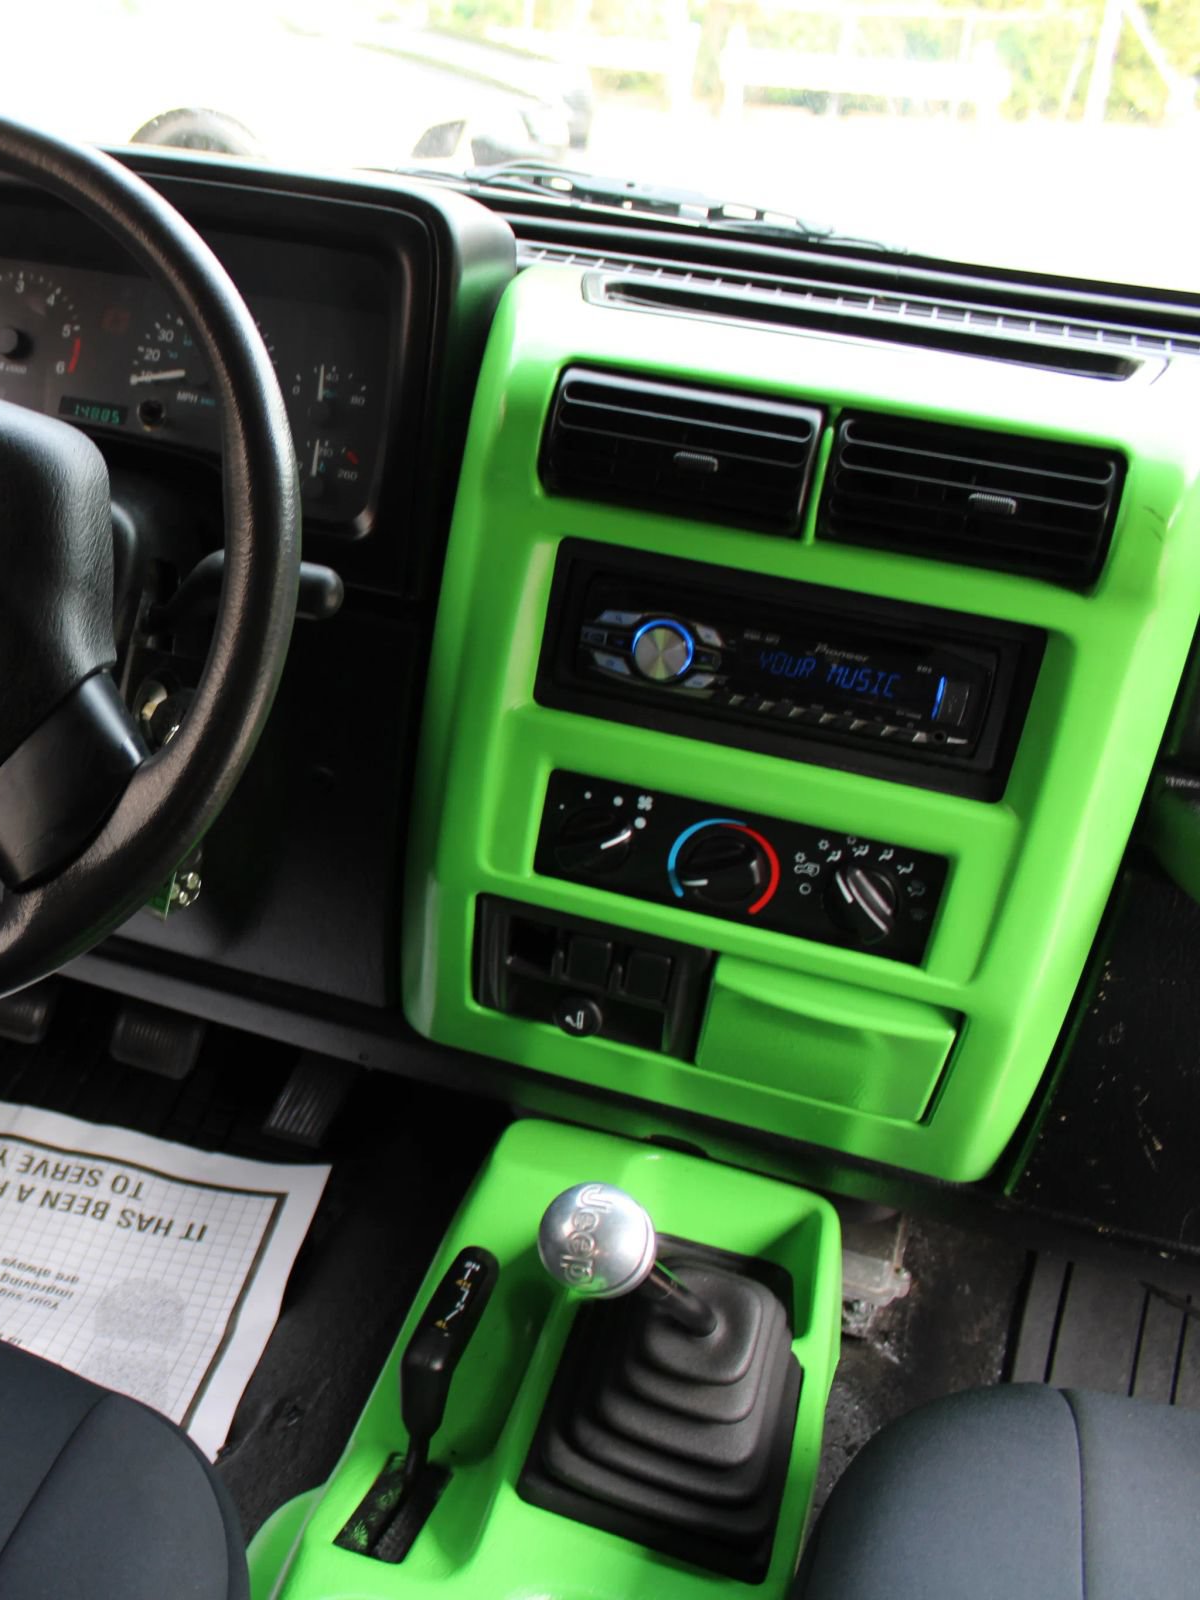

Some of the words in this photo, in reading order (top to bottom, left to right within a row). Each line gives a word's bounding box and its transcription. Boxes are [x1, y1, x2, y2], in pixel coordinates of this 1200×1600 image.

[15, 279, 25, 294] 3
[45, 293, 56, 307] 4
[62, 324, 71, 338] 5
[157, 328, 175, 343] 30
[144, 347, 161, 362] 20
[56, 361, 66, 375] 6
[814, 642, 870, 663] Pioneer
[758, 649, 817, 680] YOUR
[825, 662, 902, 700] MUSIC
[15, 1154, 104, 1188] SERVE
[16, 1183, 36, 1204] A
[110, 1173, 146, 1201] TO
[39, 1189, 111, 1222] BEEN
[115, 1207, 175, 1238] HAS
[178, 1222, 209, 1243] IT
[560, 1183, 614, 1285] Jeep
[1, 1257, 52, 1280] always
[56, 1270, 80, 1286] are
[26, 1296, 60, 1311] Your
